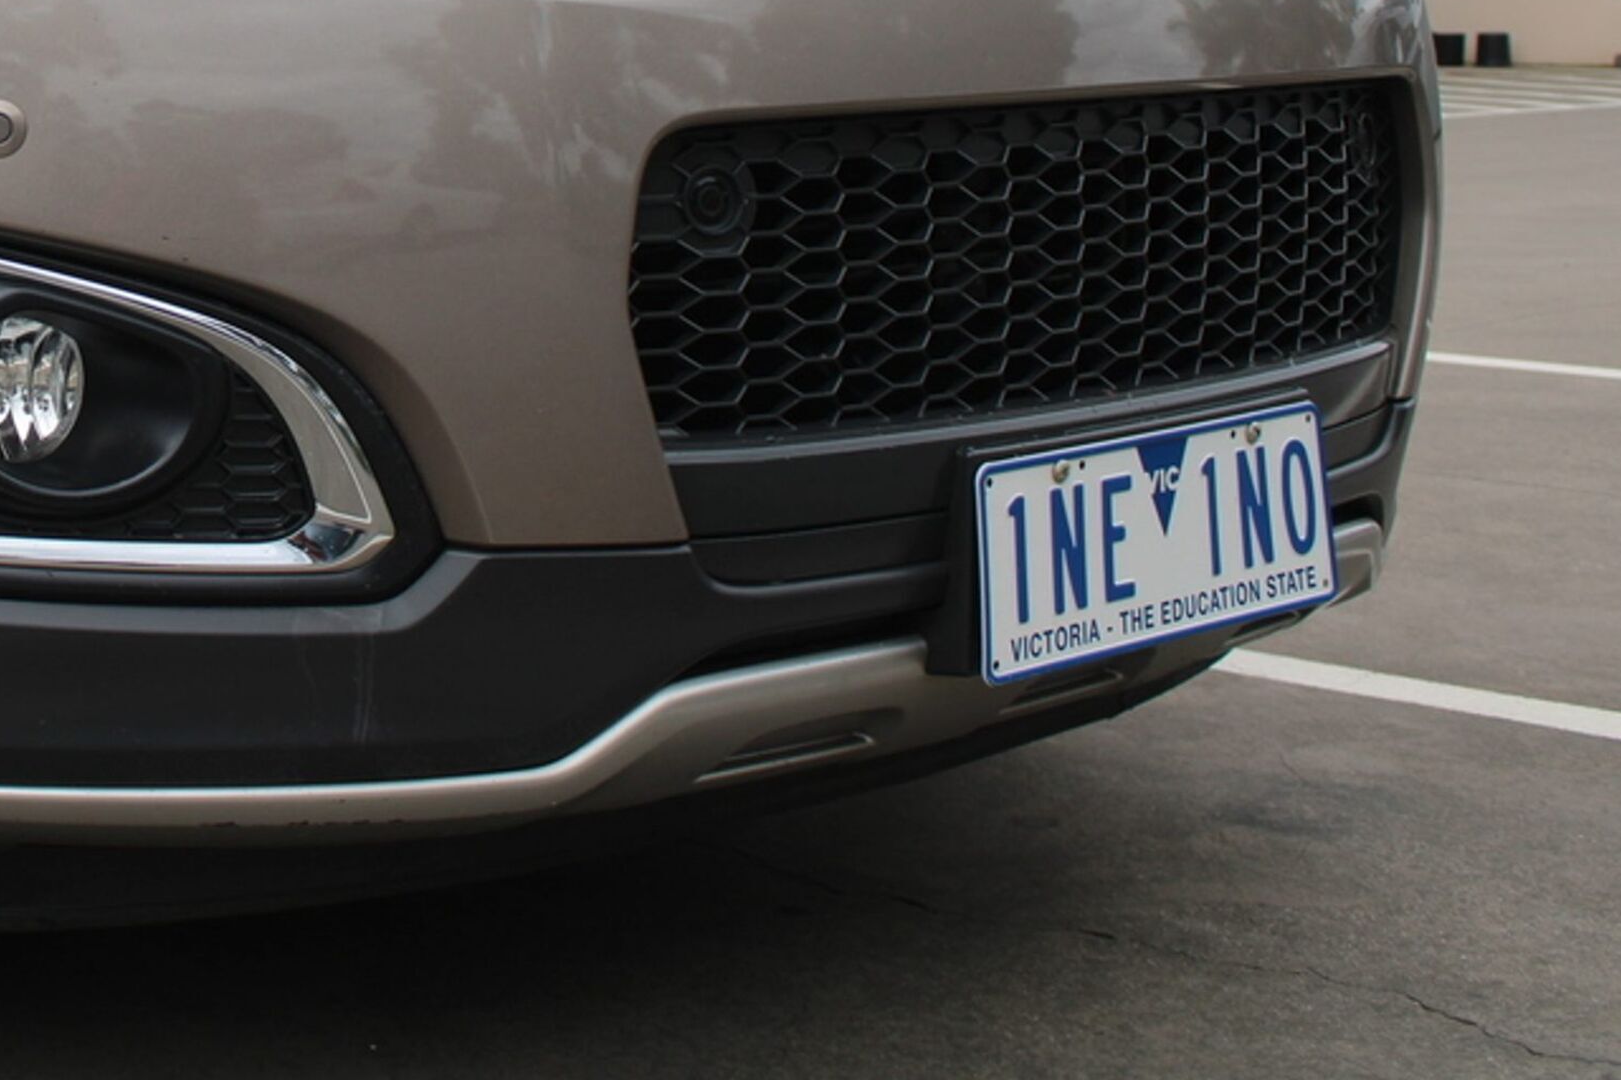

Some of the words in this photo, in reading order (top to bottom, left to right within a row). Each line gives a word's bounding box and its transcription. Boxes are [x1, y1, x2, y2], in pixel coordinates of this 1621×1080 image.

[1146, 466, 1181, 494] VIC
[1007, 474, 1136, 624] 1NE
[1200, 438, 1317, 577] 1NO
[1011, 618, 1101, 662] VICTORIA
[1119, 604, 1155, 635] THE
[1160, 578, 1261, 626] EDUCATION
[1267, 565, 1317, 599] STATE
